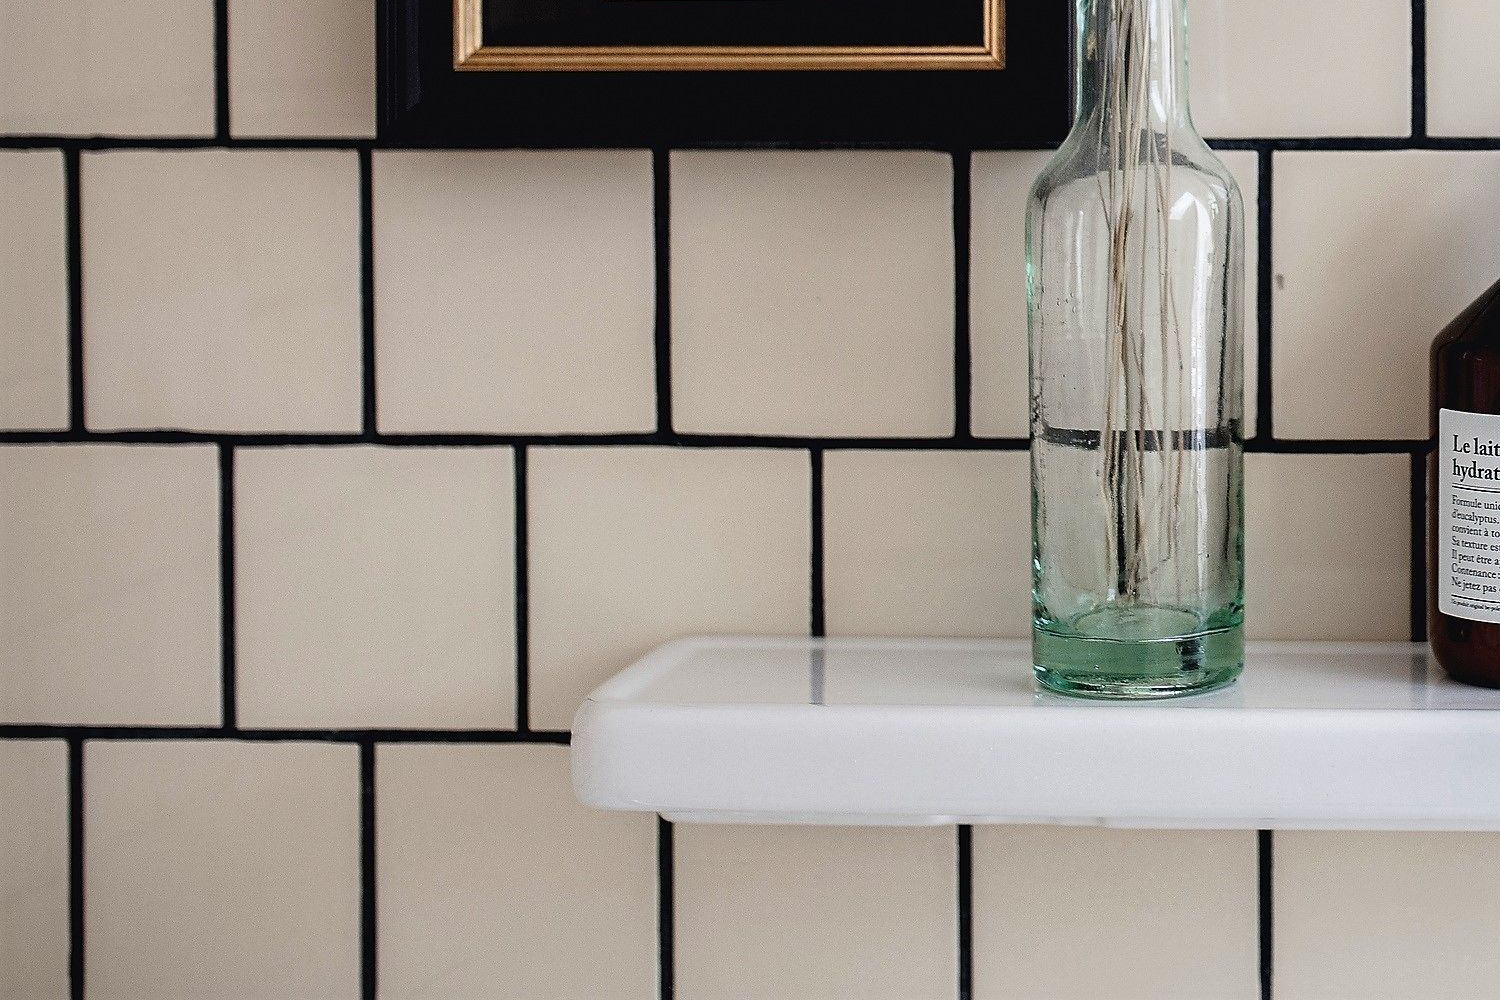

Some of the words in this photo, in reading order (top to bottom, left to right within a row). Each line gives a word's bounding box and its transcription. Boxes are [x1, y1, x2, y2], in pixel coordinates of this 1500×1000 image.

[1453, 435, 1470, 453] Le
[1473, 438, 1500, 456] lait
[1452, 495, 1482, 509] Formule
[1452, 525, 1482, 535] convient
[1484, 526, 1489, 536] à
[1452, 536, 1460, 546] Sa
[1461, 539, 1488, 550] texture
[1452, 549, 1457, 559] Il
[1459, 553, 1474, 563] peut
[1476, 553, 1492, 564] être
[1462, 579, 1480, 591] jetez
[1483, 584, 1496, 594] pas
